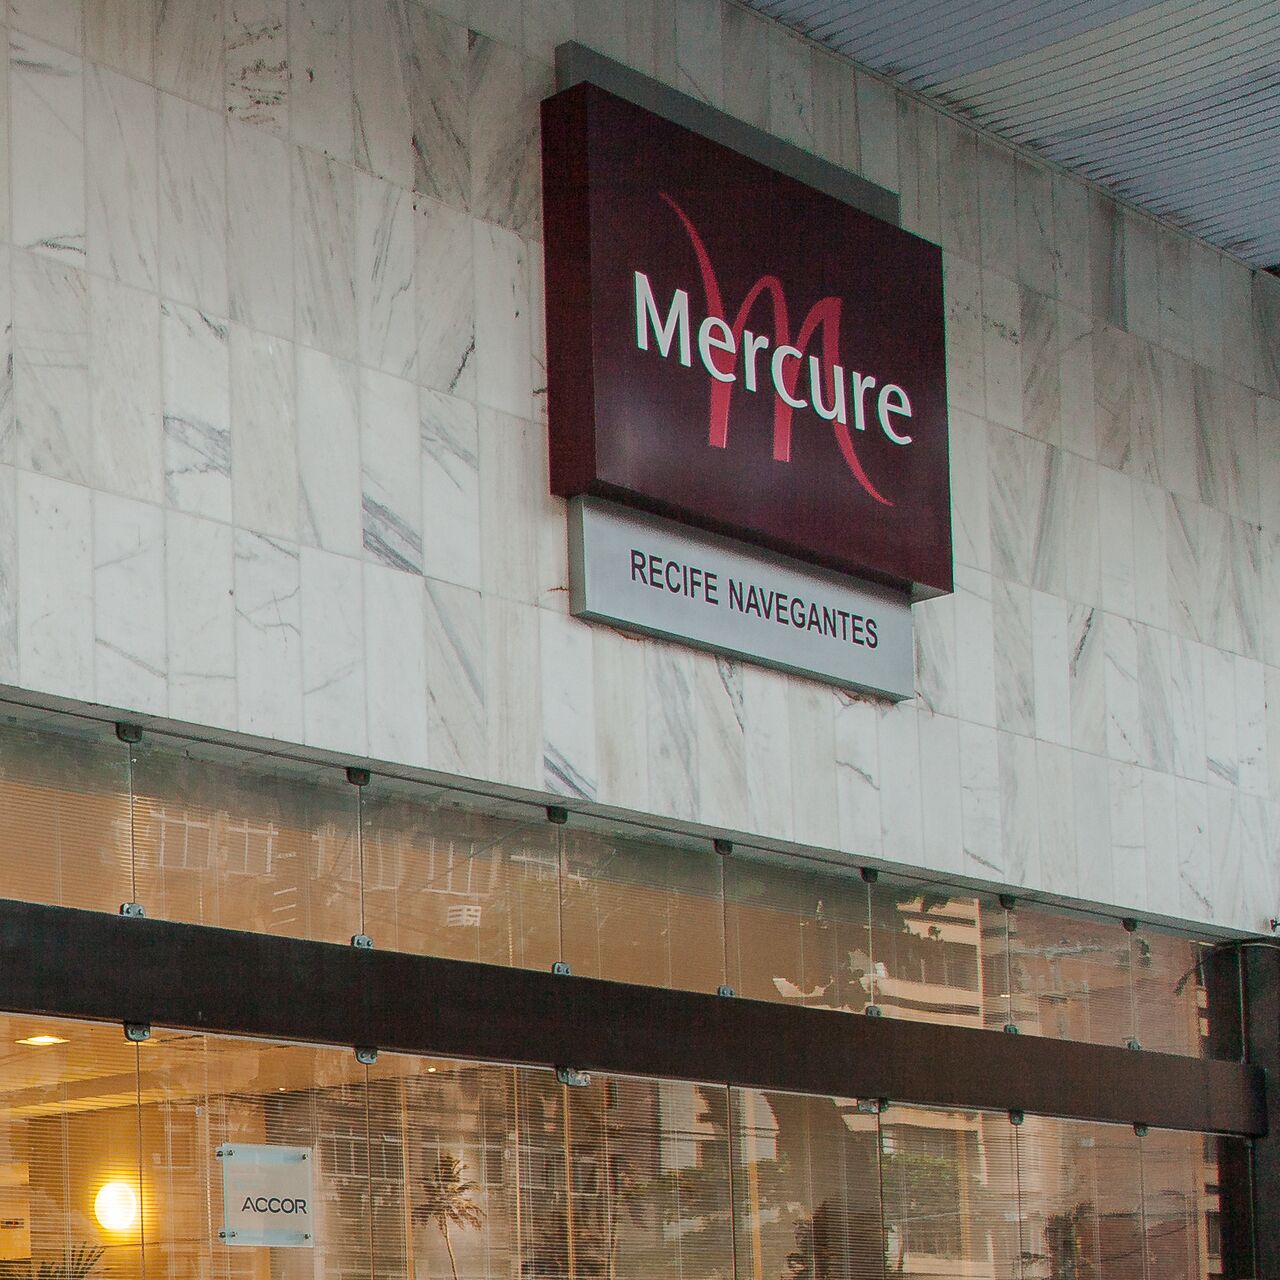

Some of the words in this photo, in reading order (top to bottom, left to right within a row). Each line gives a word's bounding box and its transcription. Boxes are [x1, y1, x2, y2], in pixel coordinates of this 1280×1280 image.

[634, 270, 913, 446] Mercure
[630, 549, 719, 605] RECIFE
[728, 578, 878, 649] NAVEGANTES
[241, 1196, 308, 1215] ACCOR
